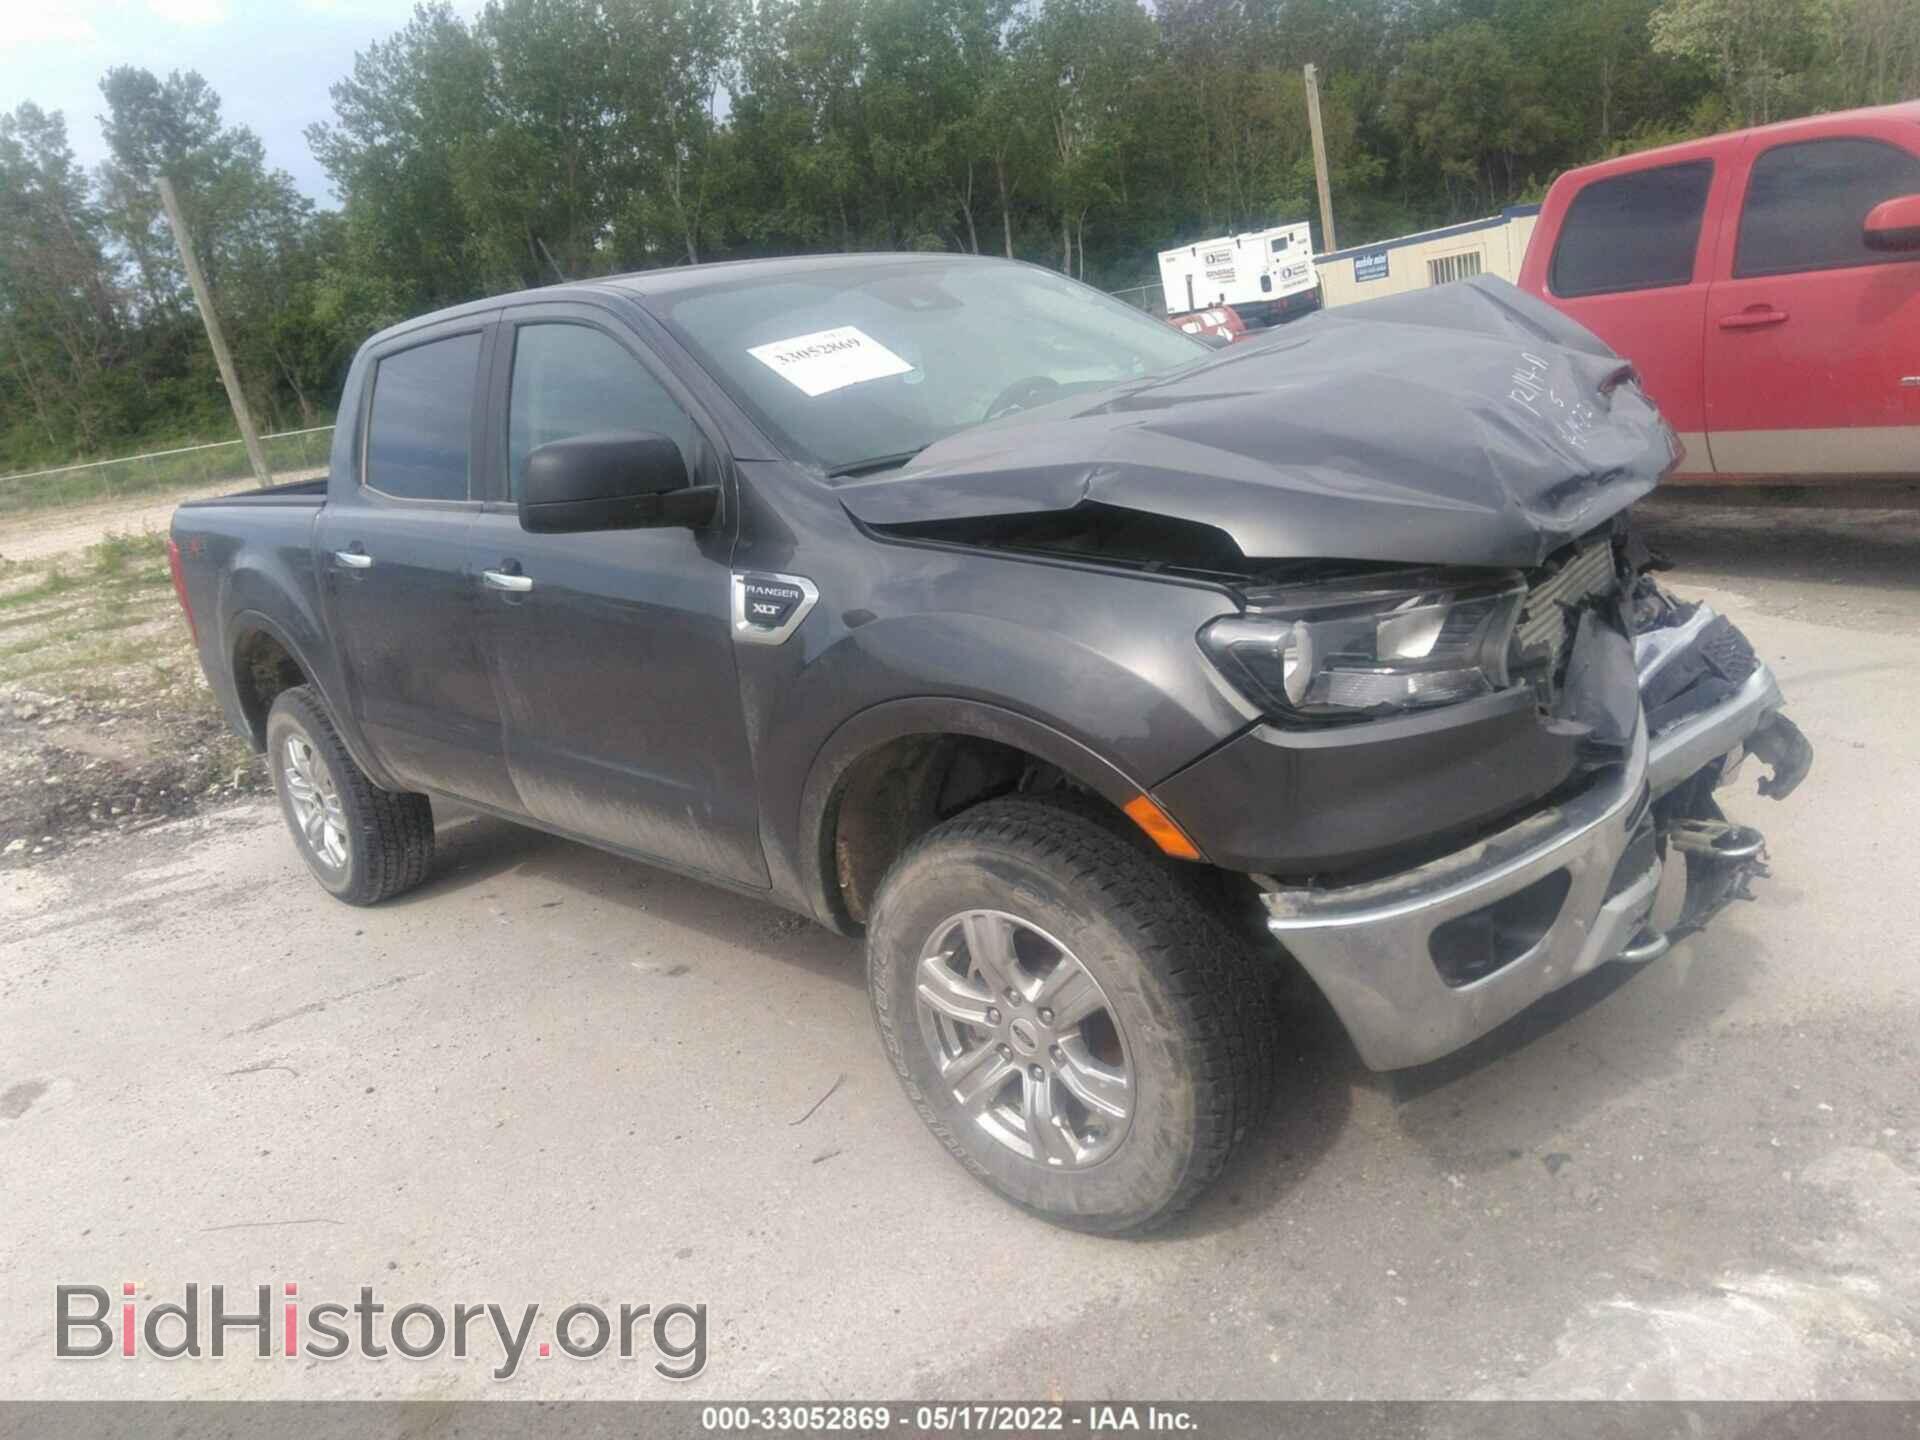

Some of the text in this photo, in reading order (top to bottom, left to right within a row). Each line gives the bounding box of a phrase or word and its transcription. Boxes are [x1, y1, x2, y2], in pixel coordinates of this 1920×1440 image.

[775, 337, 861, 365] 33052869
[746, 584, 799, 599] RANGER
[753, 602, 781, 615] XLT
